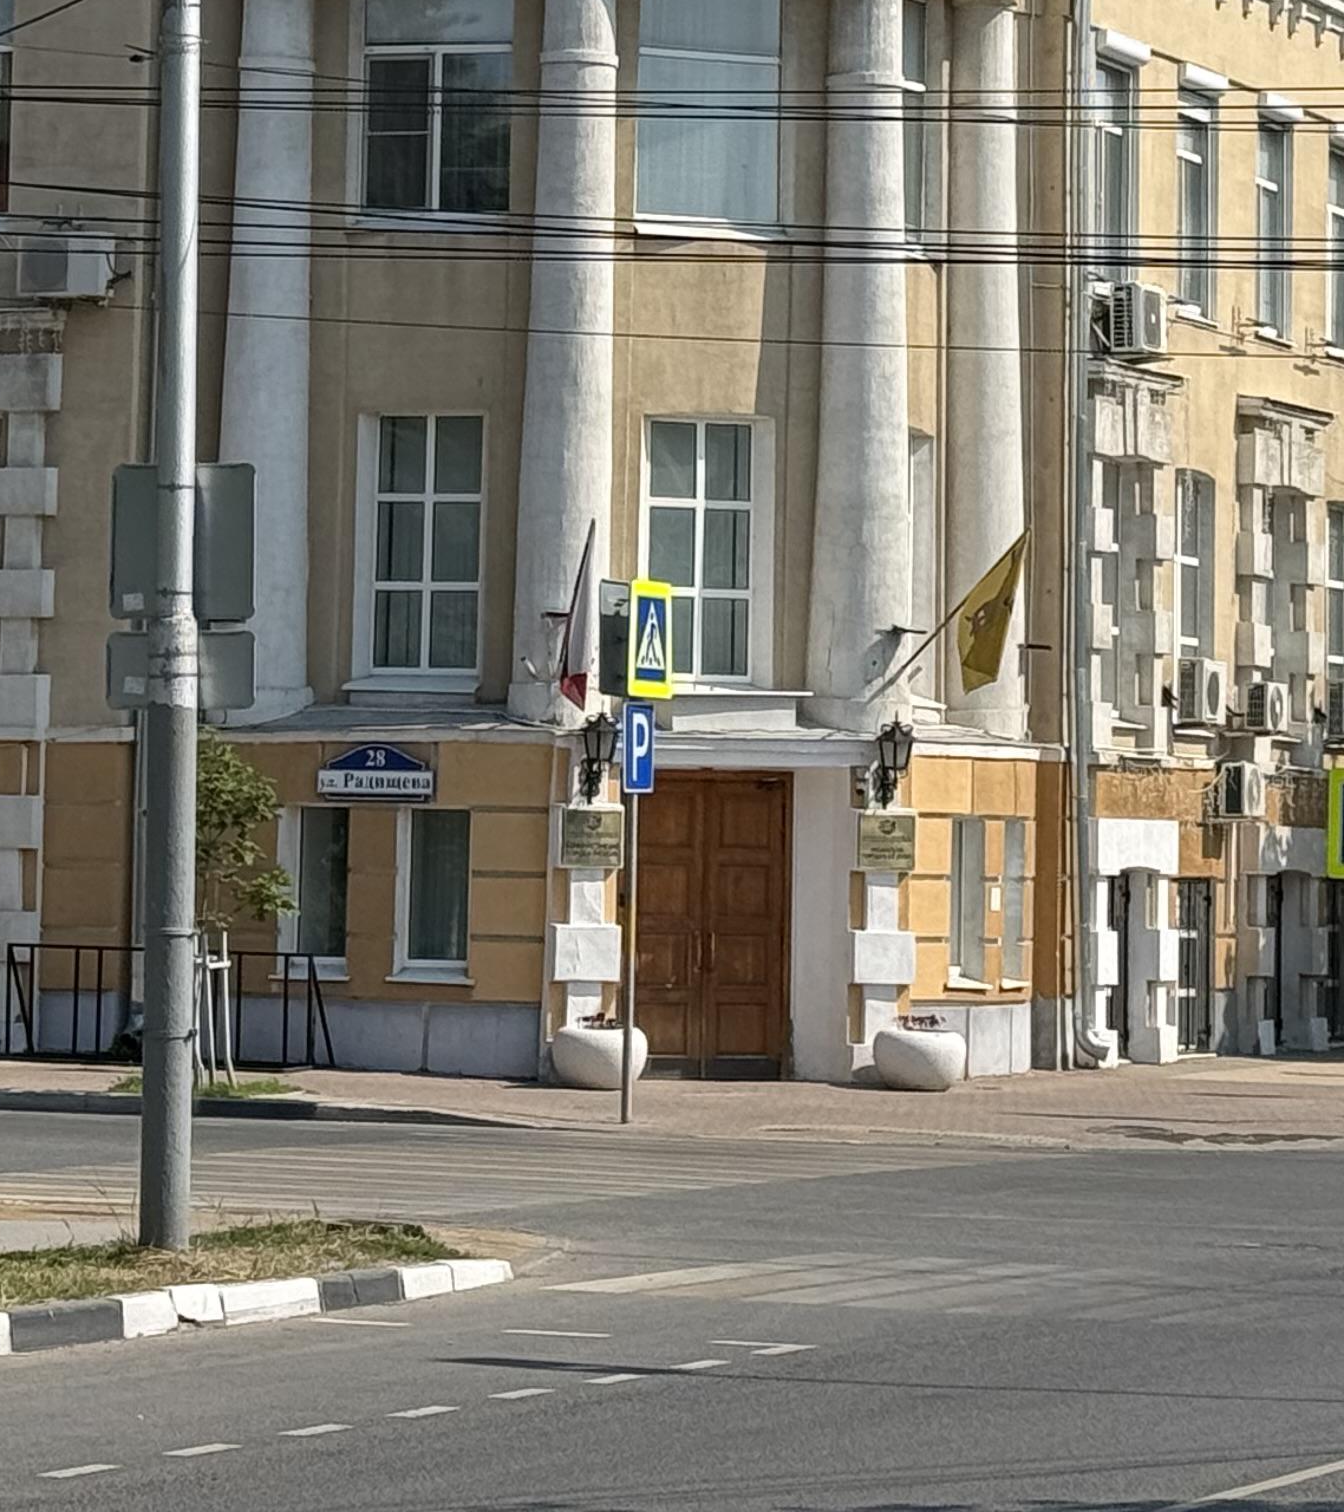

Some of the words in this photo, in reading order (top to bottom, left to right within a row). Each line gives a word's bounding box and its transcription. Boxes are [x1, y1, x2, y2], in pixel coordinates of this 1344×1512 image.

[632, 712, 649, 782] P
[364, 749, 386, 767] 28
[343, 772, 431, 790] Радищева
